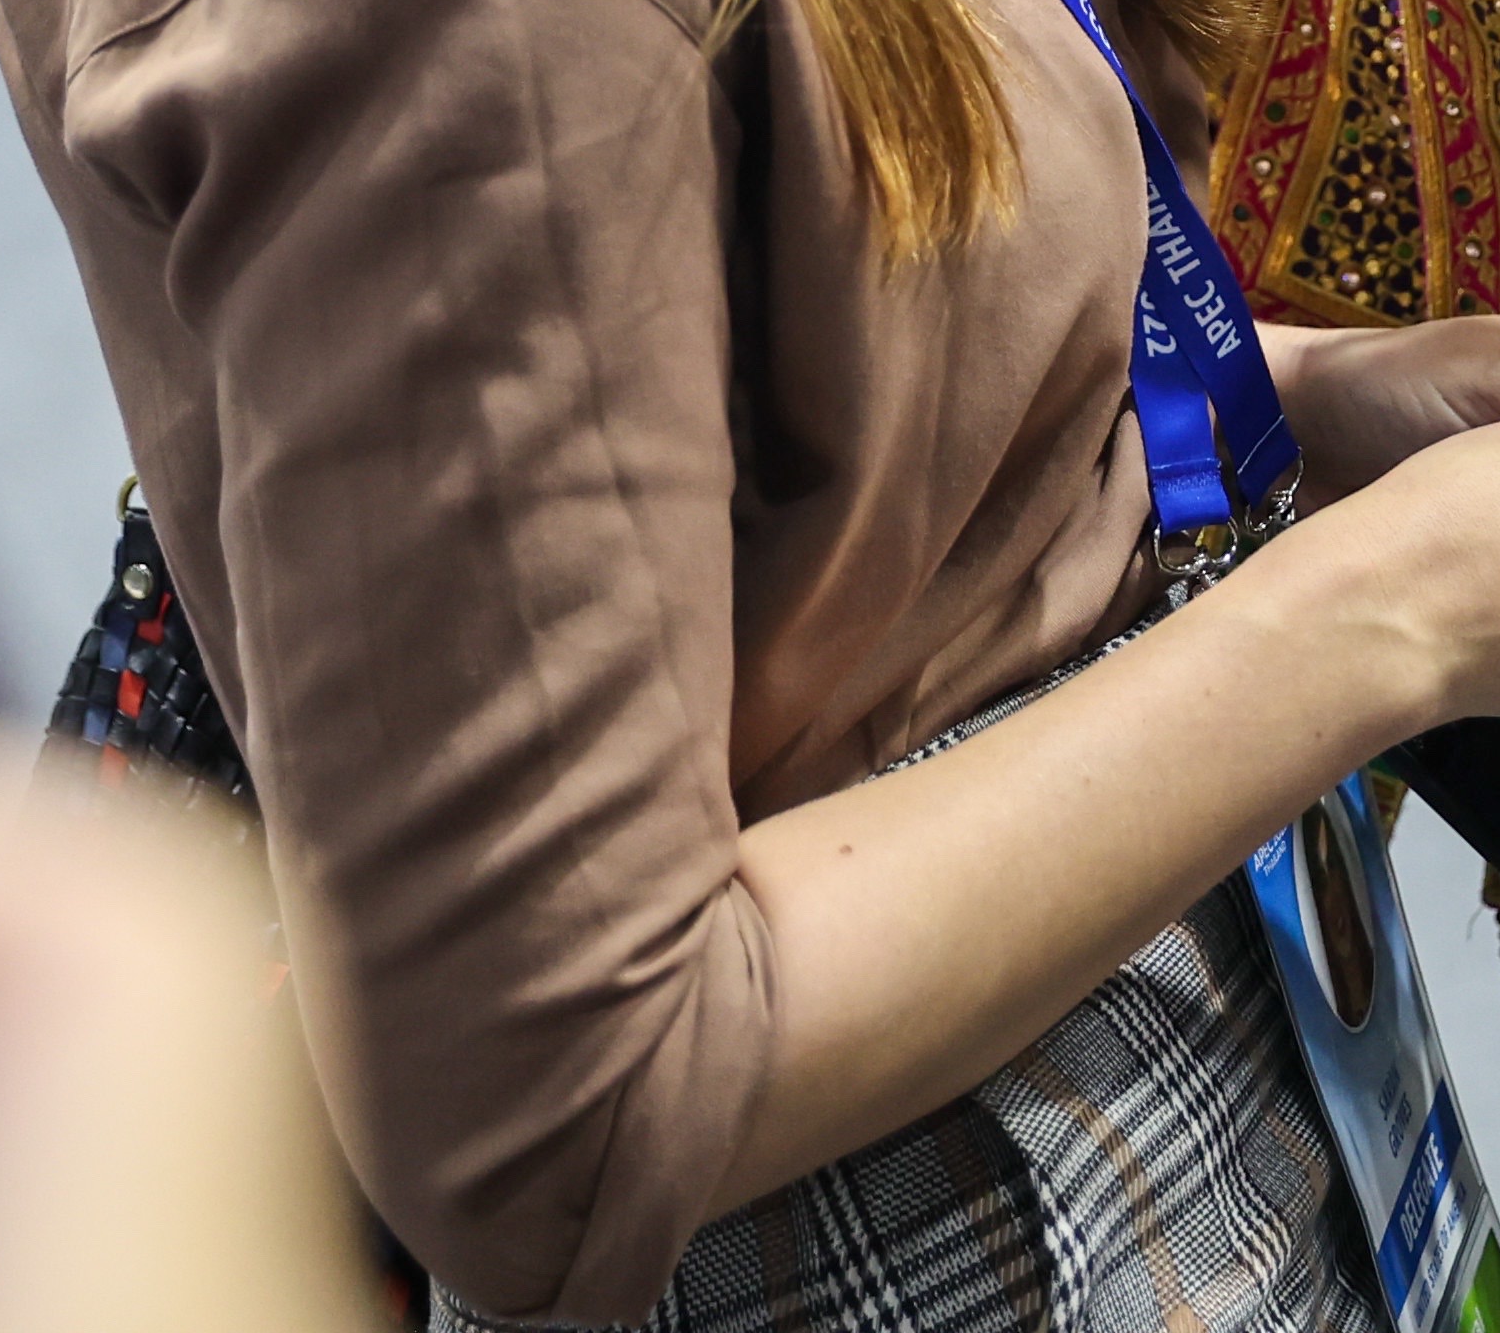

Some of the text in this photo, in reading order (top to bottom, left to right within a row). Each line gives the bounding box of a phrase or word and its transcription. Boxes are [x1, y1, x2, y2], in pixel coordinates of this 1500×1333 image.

[1147, 176, 1242, 359] APEC THAIL
[1400, 1131, 1444, 1253] DELEGATE
